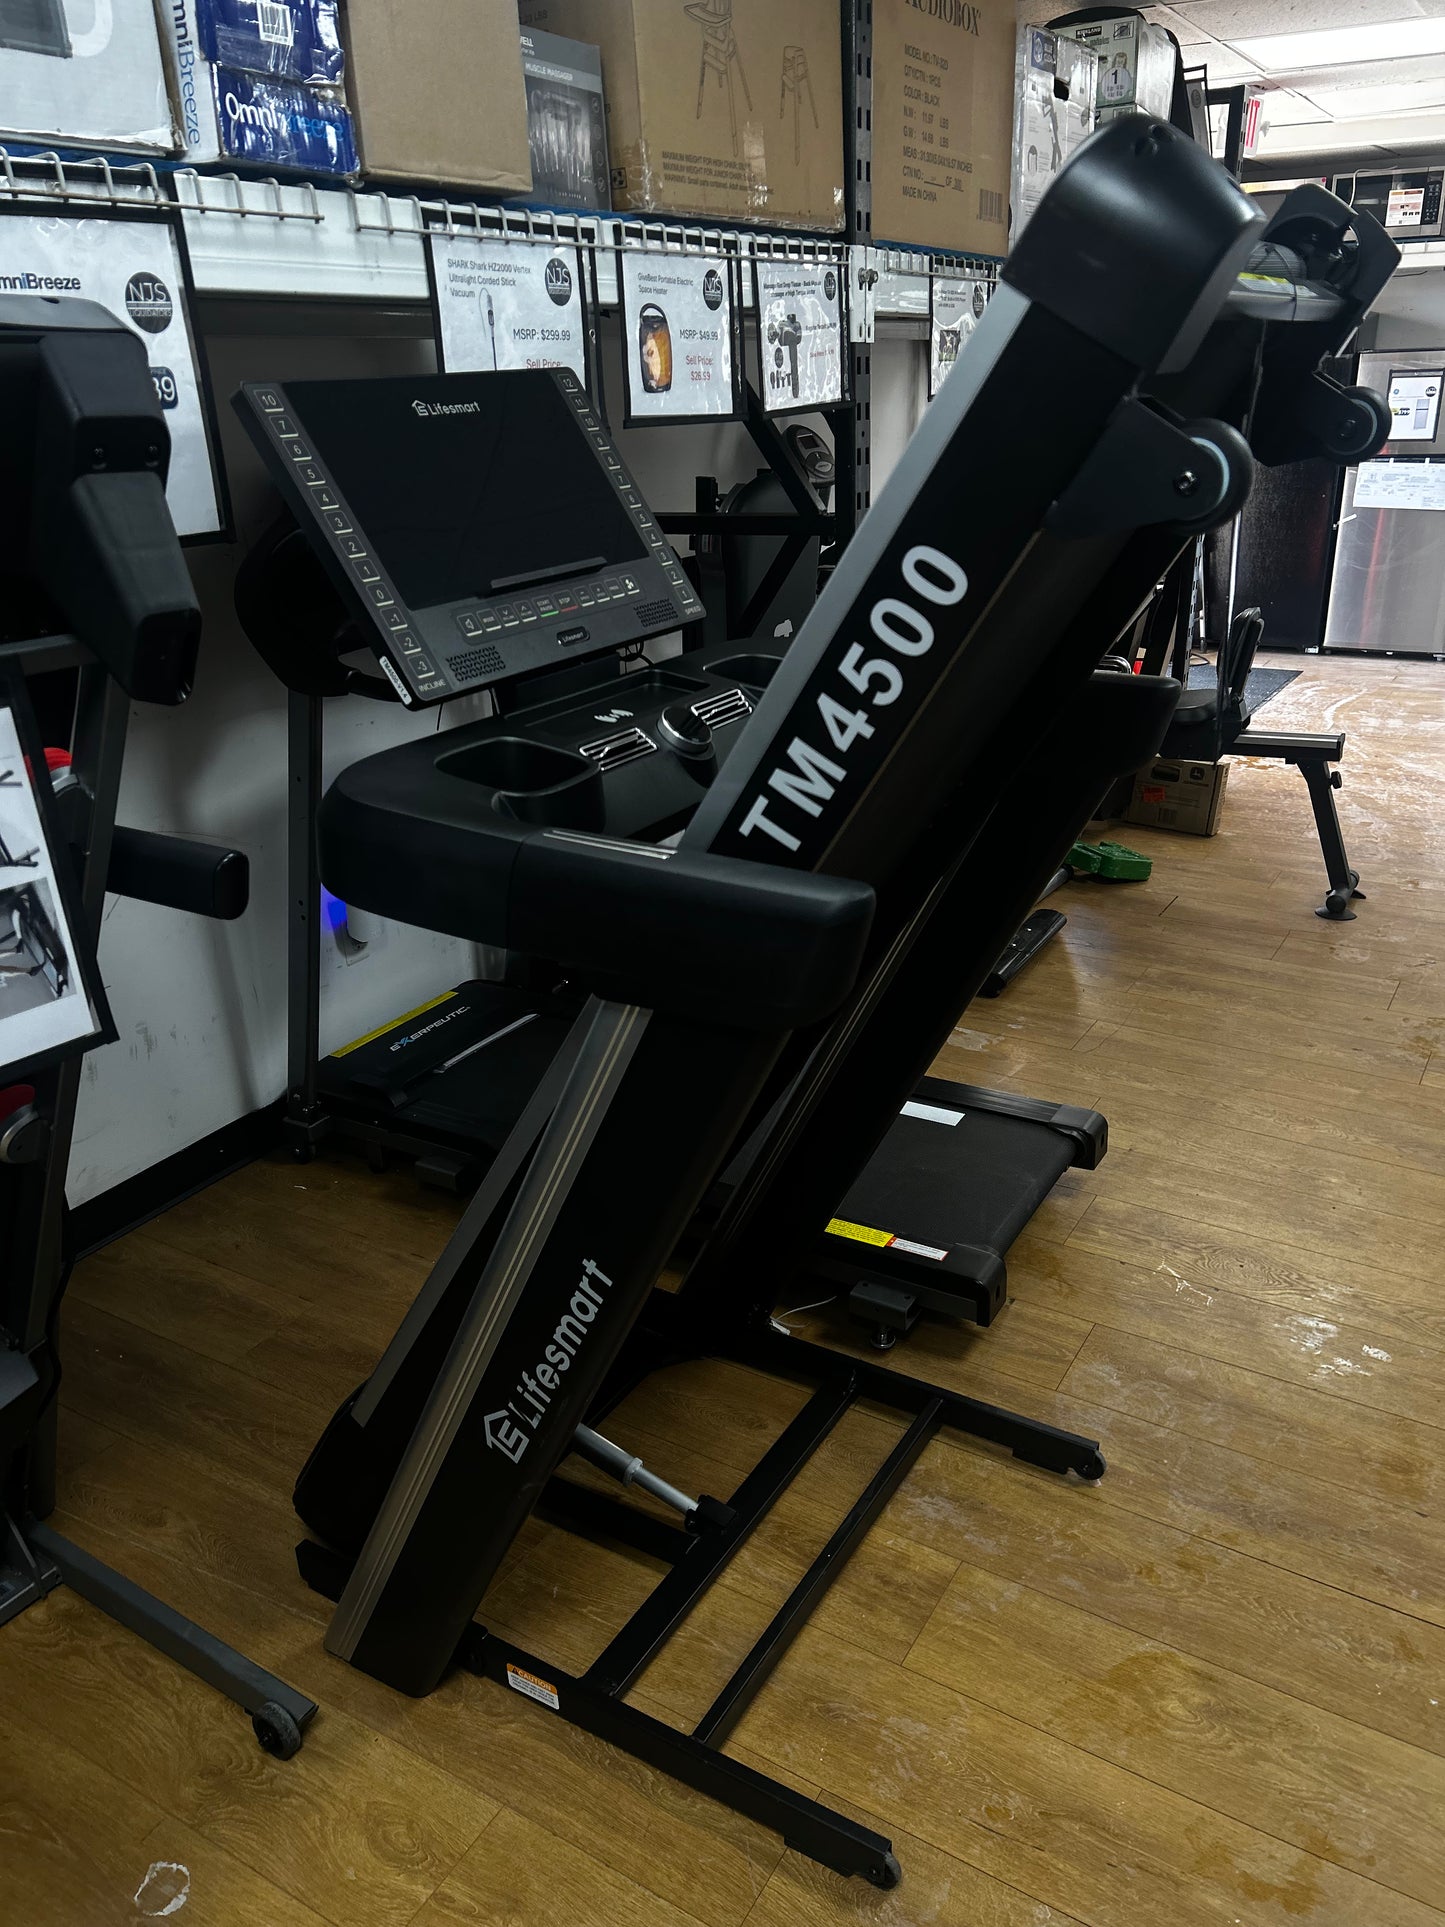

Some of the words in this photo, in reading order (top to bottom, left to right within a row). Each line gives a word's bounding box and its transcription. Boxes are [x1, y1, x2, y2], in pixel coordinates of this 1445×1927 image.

[904, 0, 979, 36] DIOBOX
[525, 62, 546, 75] MUSCLE
[1111, 70, 1119, 85] 1
[685, 154, 702, 163] WEIGHT
[702, 156, 712, 166] FOR
[903, 186, 917, 199] MADE
[923, 190, 937, 203] CHINA
[447, 258, 469, 270] SHARK
[470, 261, 487, 271] Shark
[488, 262, 512, 273] HZ2000
[513, 264, 531, 274] Vertex
[449, 273, 476, 287] Ultralight
[477, 275, 500, 286] Corded
[501, 277, 516, 287] Stick
[547, 266, 570, 285] NJS
[676, 276, 694, 287] Electric
[129, 282, 168, 302] NJS
[450, 287, 475, 298] Vacuum
[639, 285, 652, 294] Space
[513, 328, 539, 341] MSRP:
[541, 328, 571, 341] $299.99
[680, 329, 698, 340] MSRP:
[699, 329, 718, 341] $49.99
[526, 358, 541, 368] Sell
[686, 355, 697, 366] Sell
[698, 355, 713, 366] Price:
[563, 379, 574, 388] 12
[262, 395, 276, 406] 10
[575, 399, 583, 407] 11
[427, 401, 480, 415] Lifesmart
[278, 420, 286, 430] 7
[585, 418, 594, 426] 10
[293, 445, 302, 455] 6
[307, 469, 315, 479] 5
[322, 493, 329, 503] 4
[335, 517, 343, 527] 3
[349, 541, 358, 551] 2
[363, 566, 371, 575] 1
[671, 571, 678, 580] 2
[376, 590, 384, 600] 0
[559, 597, 570, 605] STOP
[684, 604, 702, 616] SPEED
[390, 614, 400, 623] -1
[404, 637, 415, 647] -2
[418, 661, 428, 671] -3
[418, 679, 446, 692] INCLINE
[738, 545, 968, 852] TM4500
[508, 1258, 613, 1429] Lifesmart
[518, 1670, 552, 1692] CAUTION
